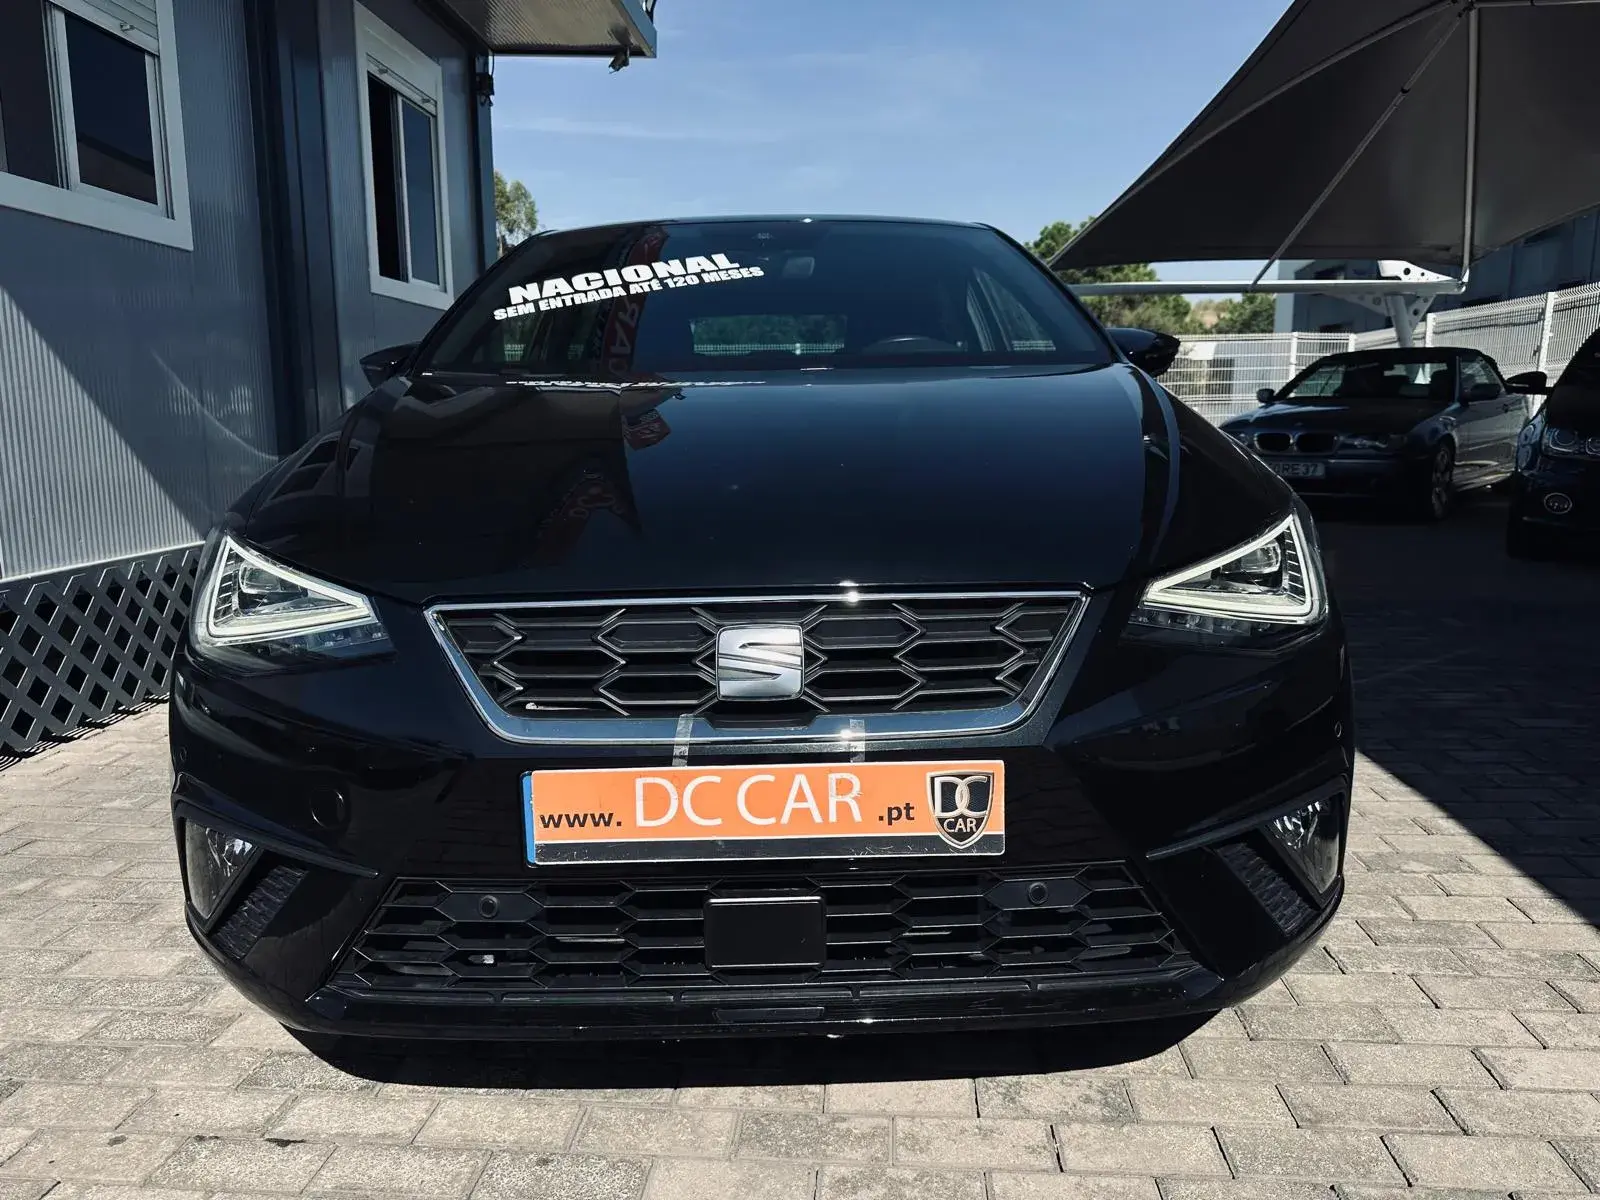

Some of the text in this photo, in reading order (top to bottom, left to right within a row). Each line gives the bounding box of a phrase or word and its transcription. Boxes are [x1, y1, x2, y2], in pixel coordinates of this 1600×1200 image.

[493, 302, 536, 320] SEM
[538, 285, 627, 311] ENTRADA
[664, 274, 700, 289] 120
[701, 266, 765, 283] MESES
[508, 253, 740, 305] NACIONAL
[540, 773, 915, 829] www. DC CAR .pt
[934, 776, 987, 818] DC
[943, 818, 977, 832] CAR
